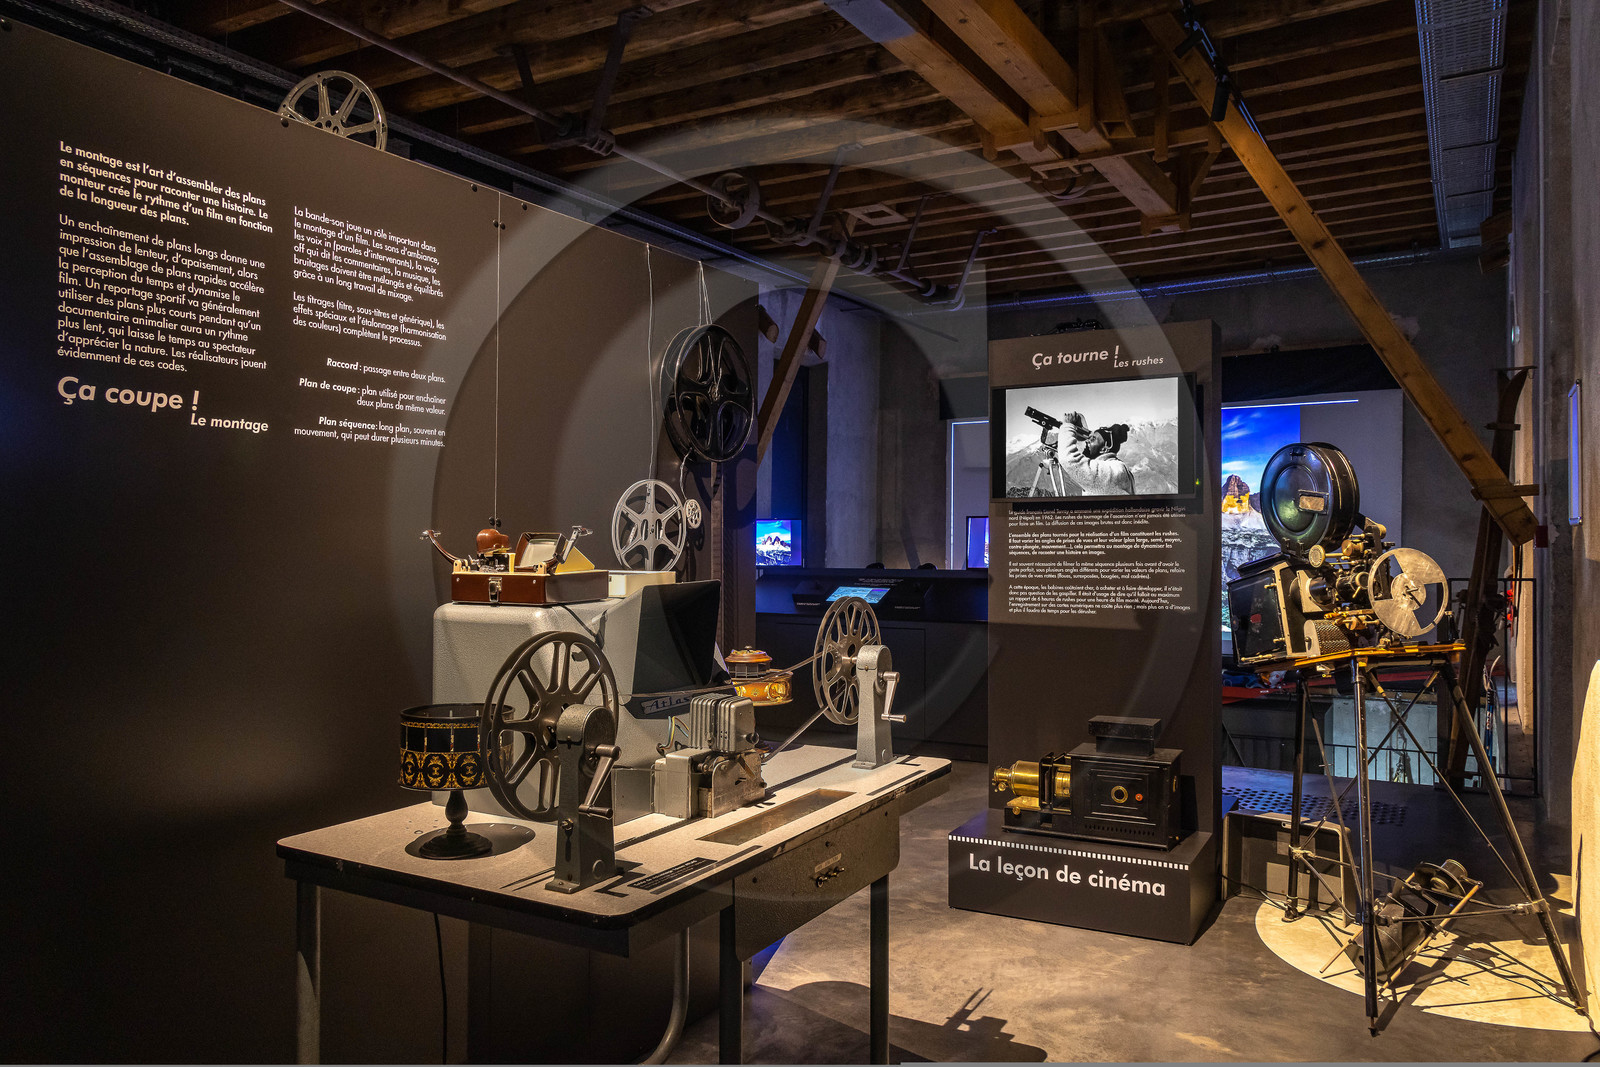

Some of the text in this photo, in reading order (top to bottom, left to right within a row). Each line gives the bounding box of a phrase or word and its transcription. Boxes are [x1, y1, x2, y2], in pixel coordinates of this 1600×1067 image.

[59, 158, 268, 220] en séquences pour raconter une histoire. Le
[60, 140, 266, 206] Le montage est l'art d'assembler des plans
[59, 173, 273, 233] monteur crée le rythme d'un film en fonction
[59, 185, 189, 226] de la longueur des plans.
[59, 213, 266, 269] Un enchaînement de plans longs donne une
[294, 205, 436, 253] La bande-son joue un rôle important dans
[58, 246, 265, 294] que l'assemblage de plans rapides accélère
[59, 228, 258, 280] impression de lenteur, d'apaisement, alors
[58, 257, 241, 302] la perception du temps et dynamise le
[58, 271, 260, 318] film. Un reportage sportif va généralement
[57, 301, 248, 342] documentaire animalier aura un rythme
[58, 288, 261, 331] utiliser des plans plus courts pendant qu'un
[57, 317, 256, 355] plus lent, qui laisse le temps au spectateur
[57, 331, 267, 369] d'apprécier la nature. Les réalisateurs jouent
[57, 346, 187, 372] évidemment de ces codes.
[363, 365, 392, 377] passage
[392, 369, 410, 378] entre
[410, 369, 427, 380] deux
[427, 372, 446, 383] plans.
[1032, 345, 1120, 370] Ça tourne !
[1114, 356, 1164, 368] Les rushes
[58, 376, 200, 412] Ça coupe !
[299, 377, 318, 388] Plan
[320, 380, 331, 390] de
[361, 385, 377, 397] plan
[378, 388, 398, 399] utilisé
[399, 393, 415, 401] pour
[415, 393, 446, 405] enchaîner
[190, 413, 269, 433] Le montage
[294, 428, 445, 447] mouvement, qui peut durer plusieurs minutes.
[318, 416, 337, 426] Plan
[378, 421, 394, 434] long
[395, 423, 412, 435] plan,
[413, 428, 437, 436] souvent
[646, 696, 690, 711] Atlas
[969, 853, 1166, 896] La leçon de cinéma
